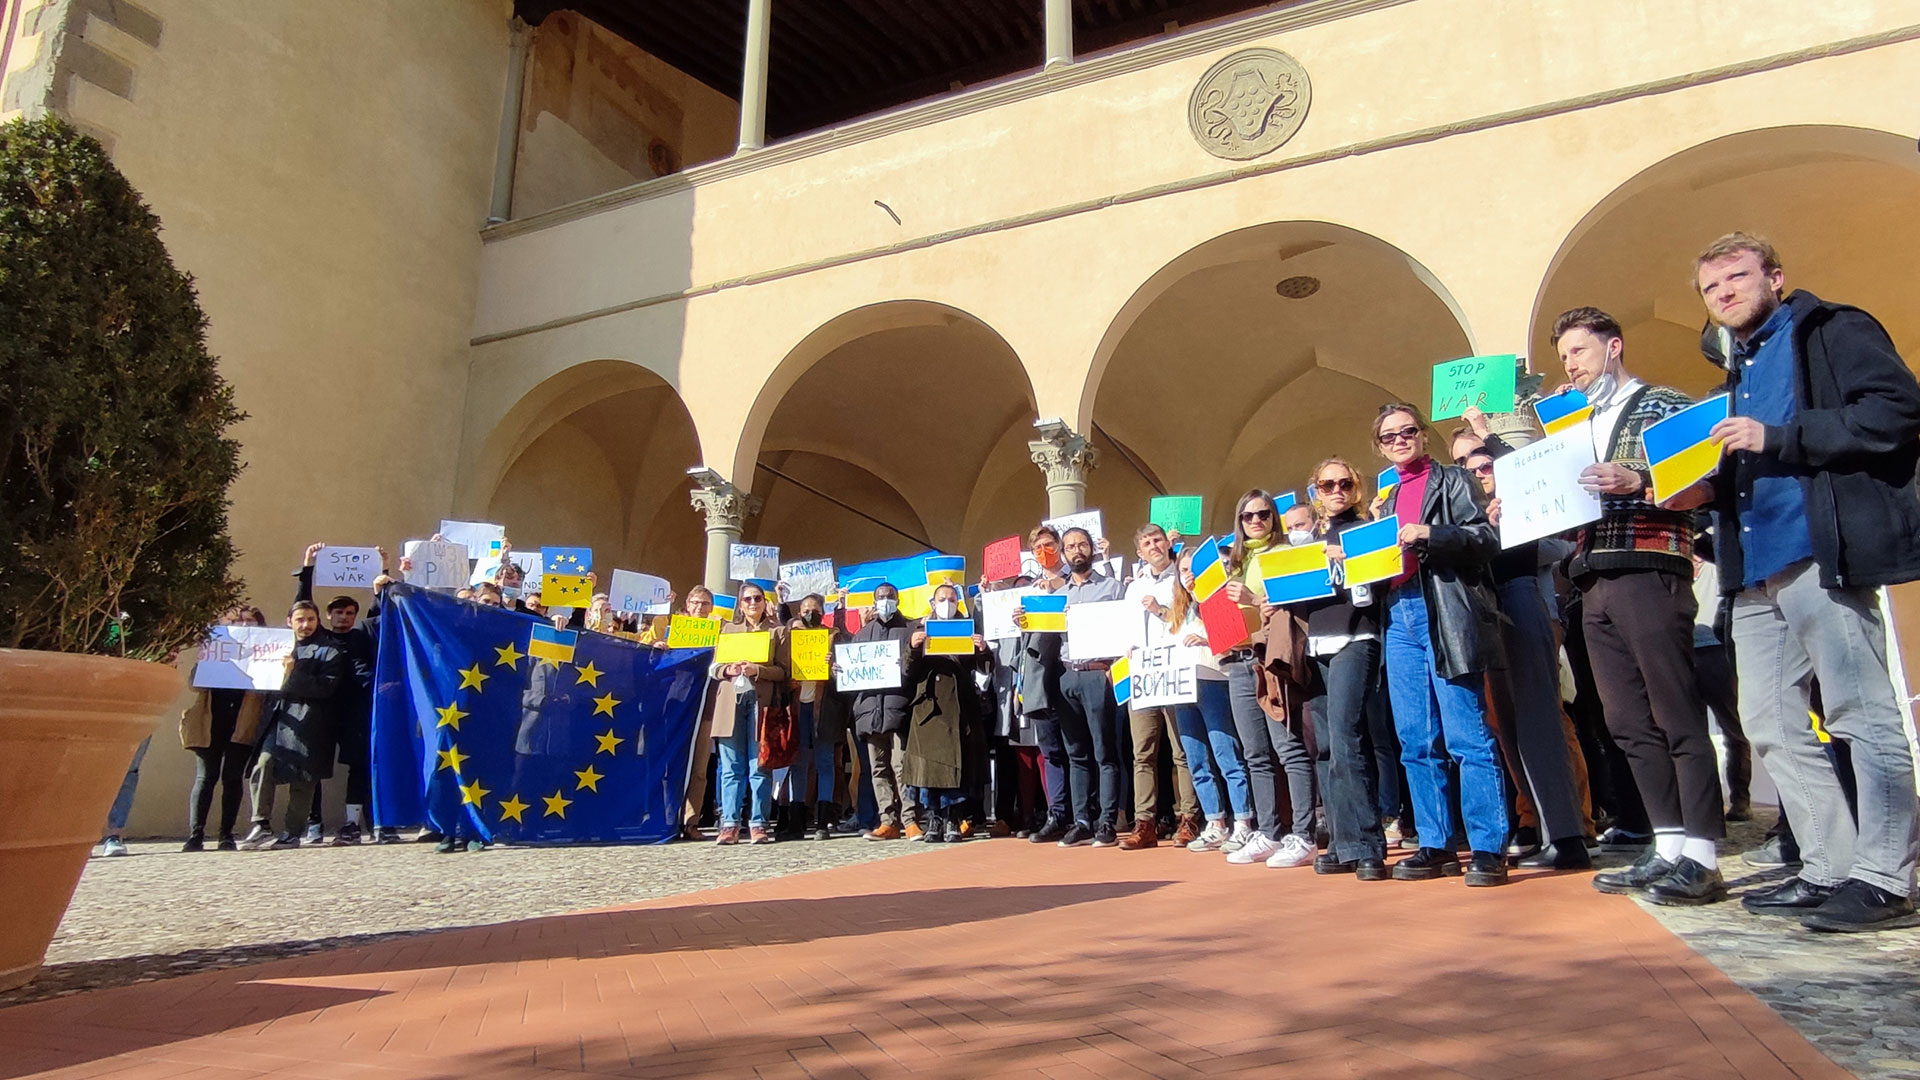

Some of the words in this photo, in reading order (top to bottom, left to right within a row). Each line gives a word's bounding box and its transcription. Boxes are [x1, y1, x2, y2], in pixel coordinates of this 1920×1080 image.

[1448, 362, 1486, 377] STOP
[1455, 380, 1476, 389] THE
[1438, 391, 1488, 412] WAR
[1513, 440, 1565, 468] Academics
[330, 552, 371, 564] STOP
[333, 571, 366, 582] WAR
[797, 634, 827, 646] STAND
[797, 651, 822, 661] WITH
[845, 645, 867, 665] WE
[873, 643, 892, 659] ARE
[1142, 645, 1176, 669] НЕТ
[841, 663, 886, 687] UKRAINE
